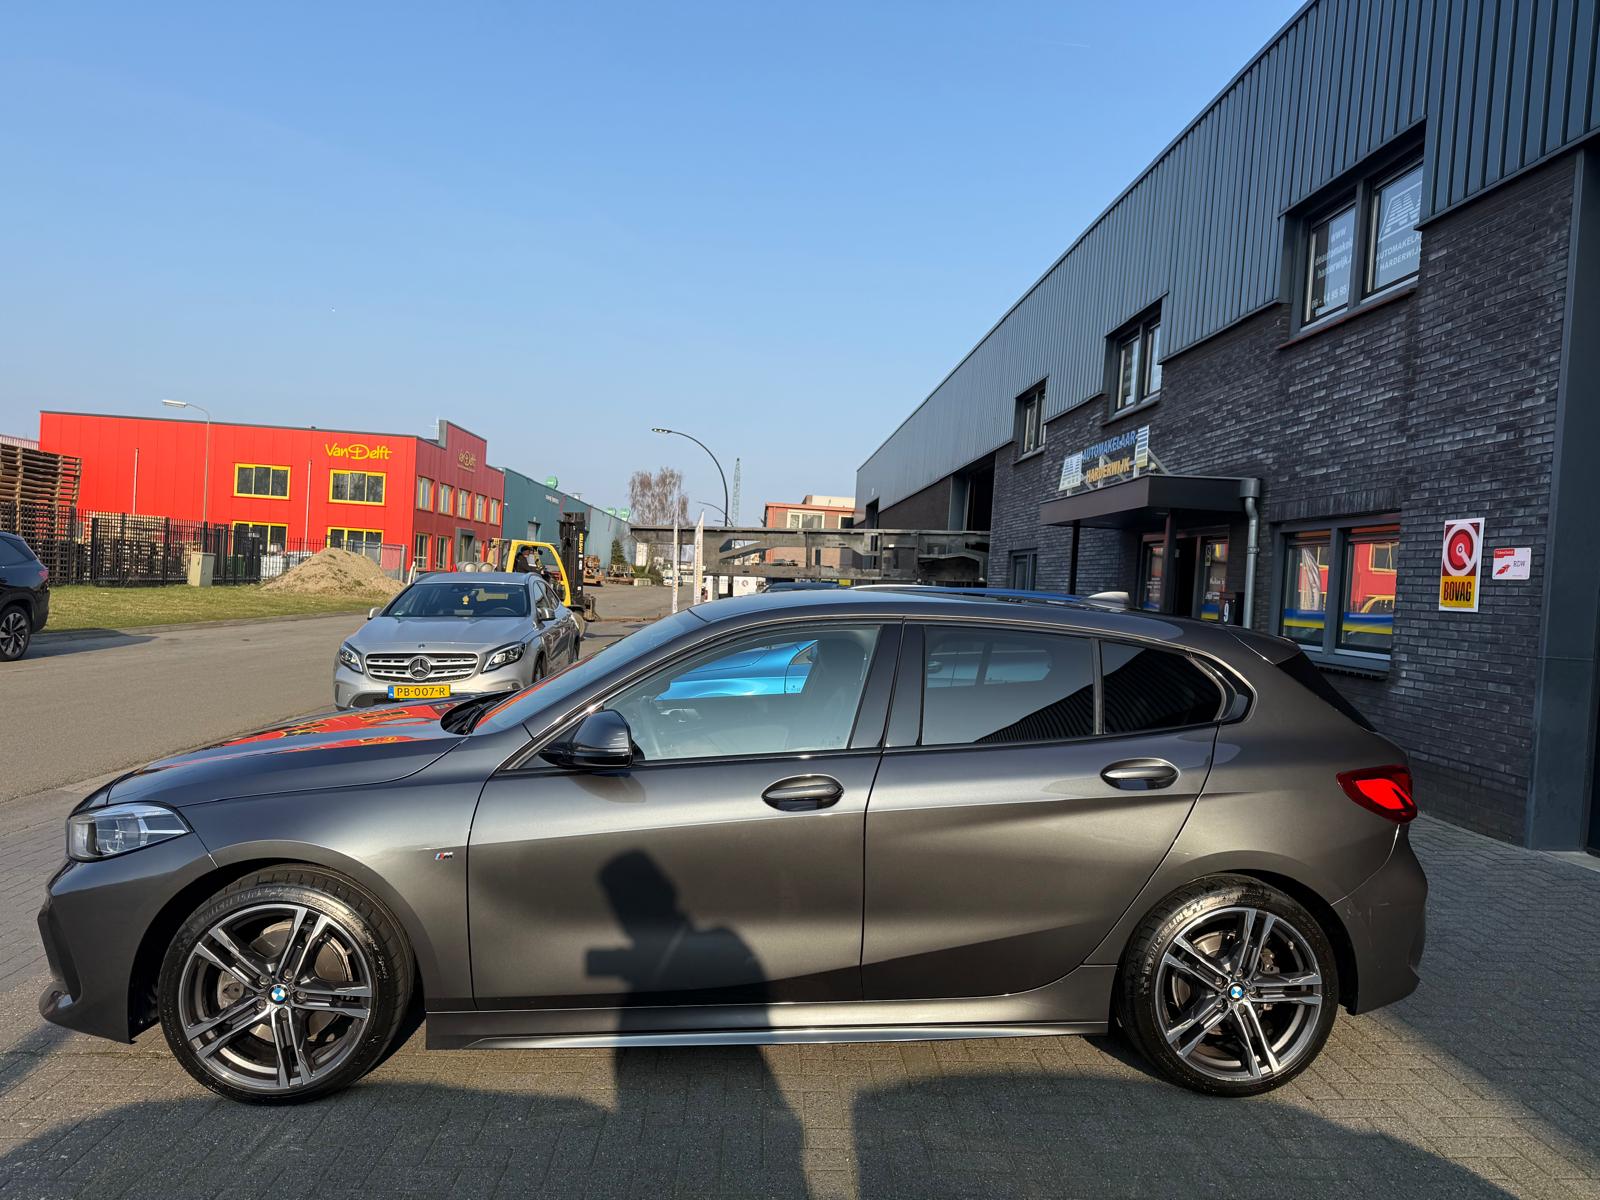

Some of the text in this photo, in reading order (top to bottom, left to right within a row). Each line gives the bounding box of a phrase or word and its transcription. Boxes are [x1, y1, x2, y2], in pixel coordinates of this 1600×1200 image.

[1379, 245, 1421, 273] HARDERWIJ
[1087, 456, 1130, 484] HARDERWIJK
[1443, 581, 1472, 602] BOVAG
[397, 687, 446, 697] PB-007-R
